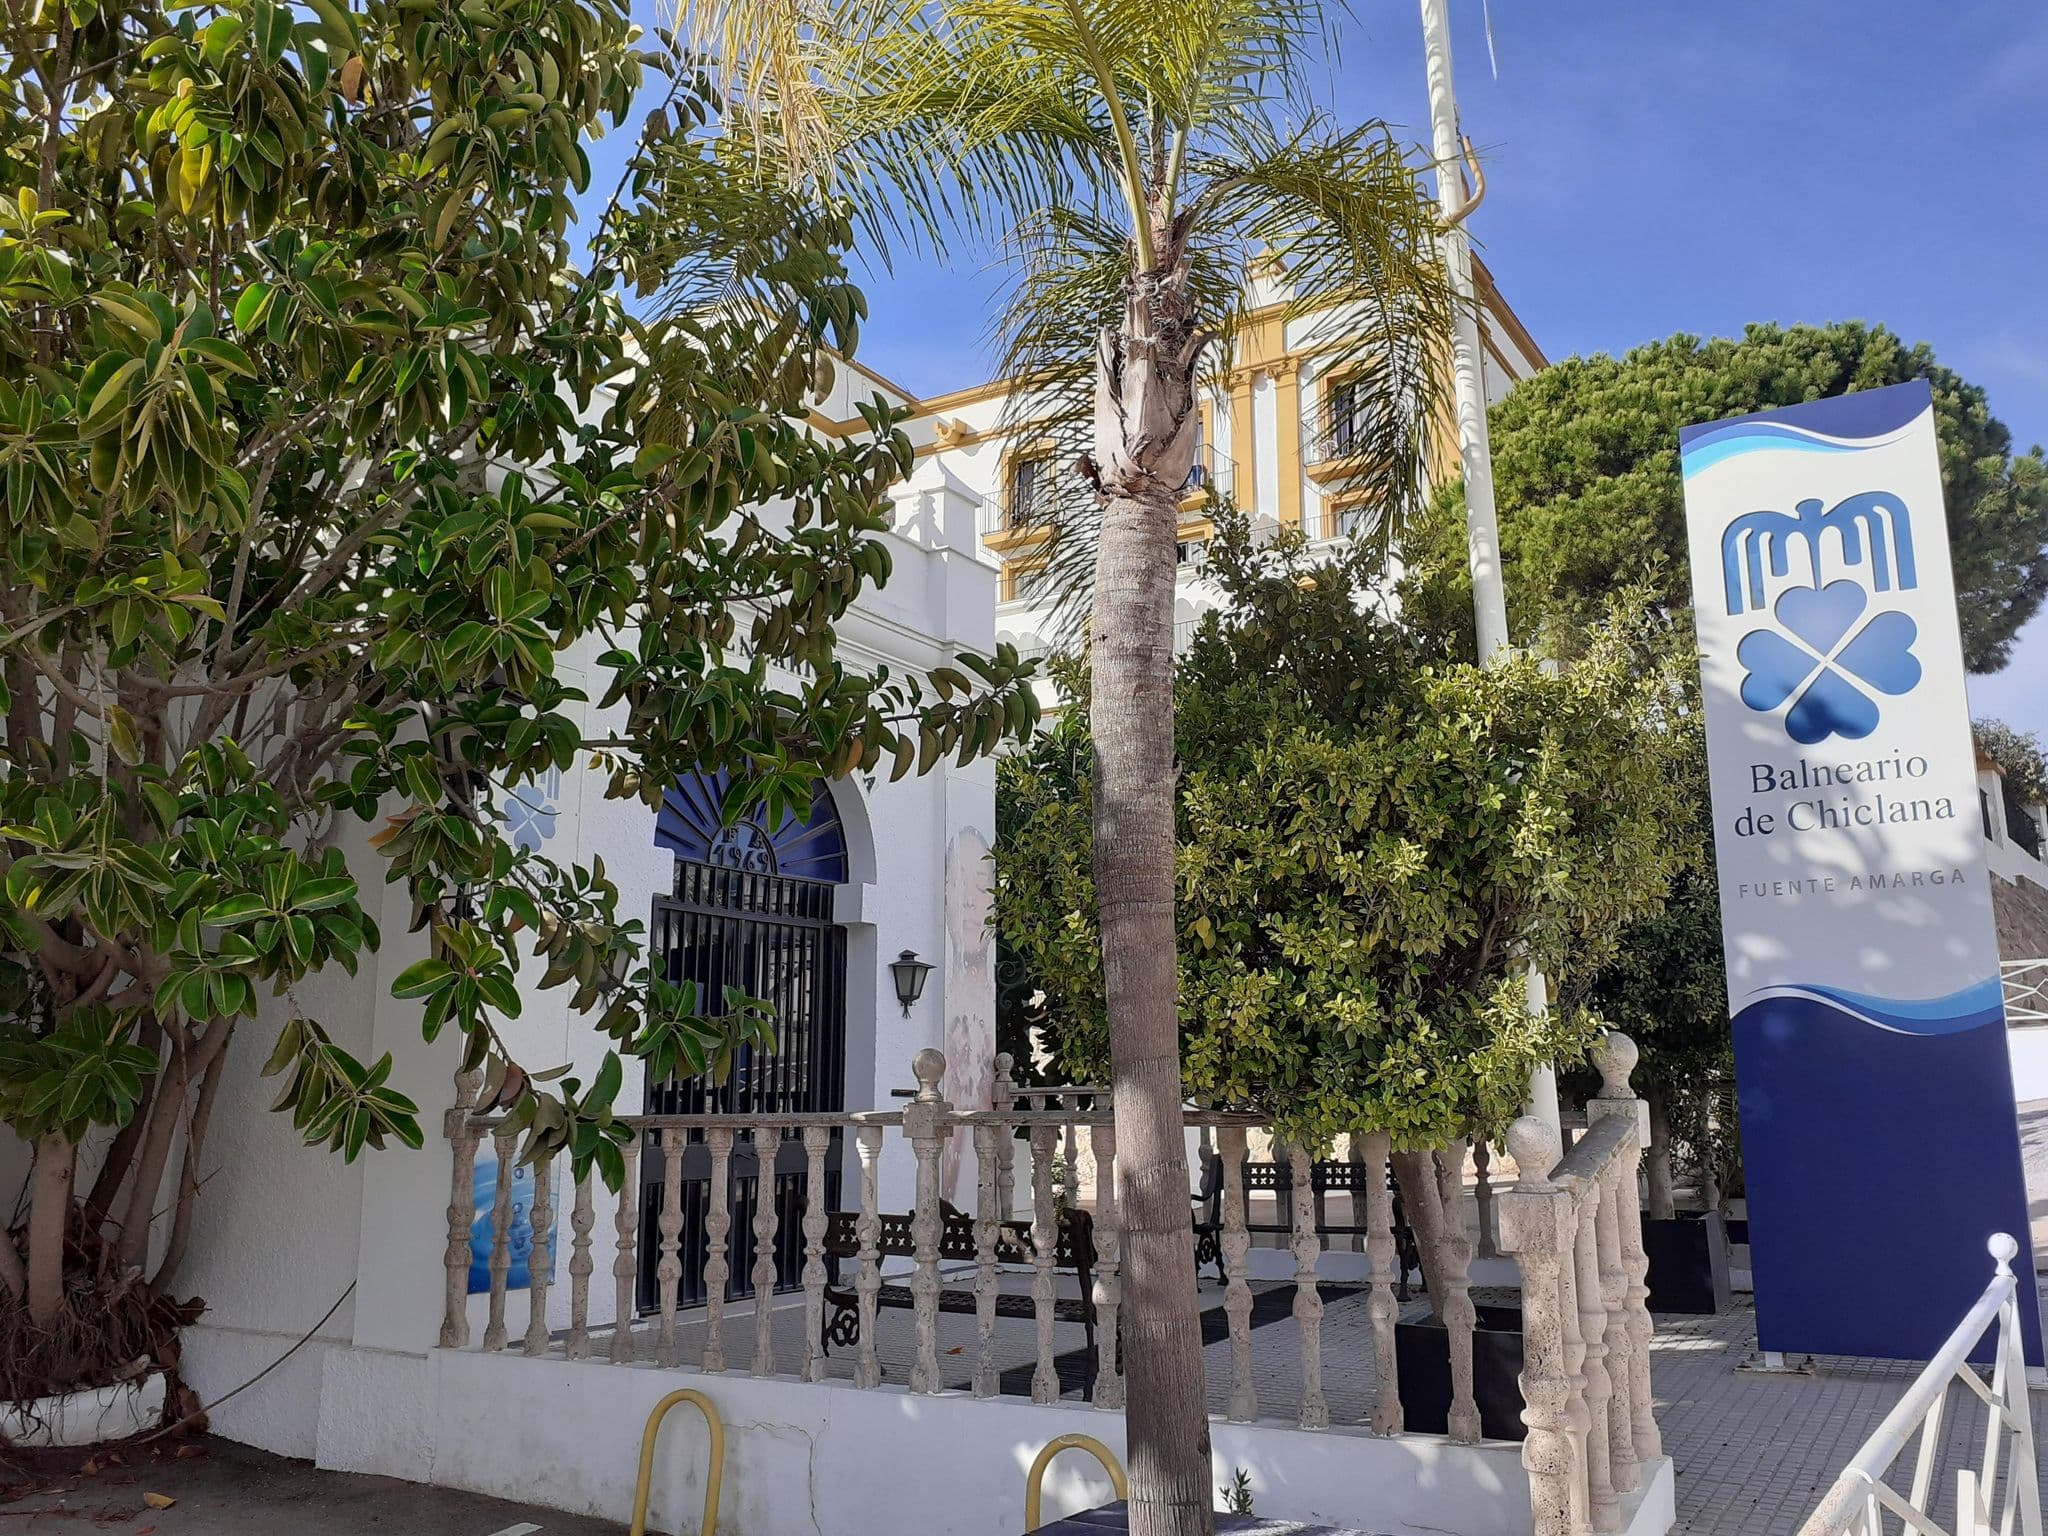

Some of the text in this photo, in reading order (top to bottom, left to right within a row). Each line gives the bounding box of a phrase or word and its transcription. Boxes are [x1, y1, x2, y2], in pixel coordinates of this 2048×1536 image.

[1750, 748, 1928, 793] Balneario
[1734, 793, 1956, 837] de Chiclana
[713, 844, 769, 873] 1969
[1738, 868, 1966, 898] FUENTE AMARGA
